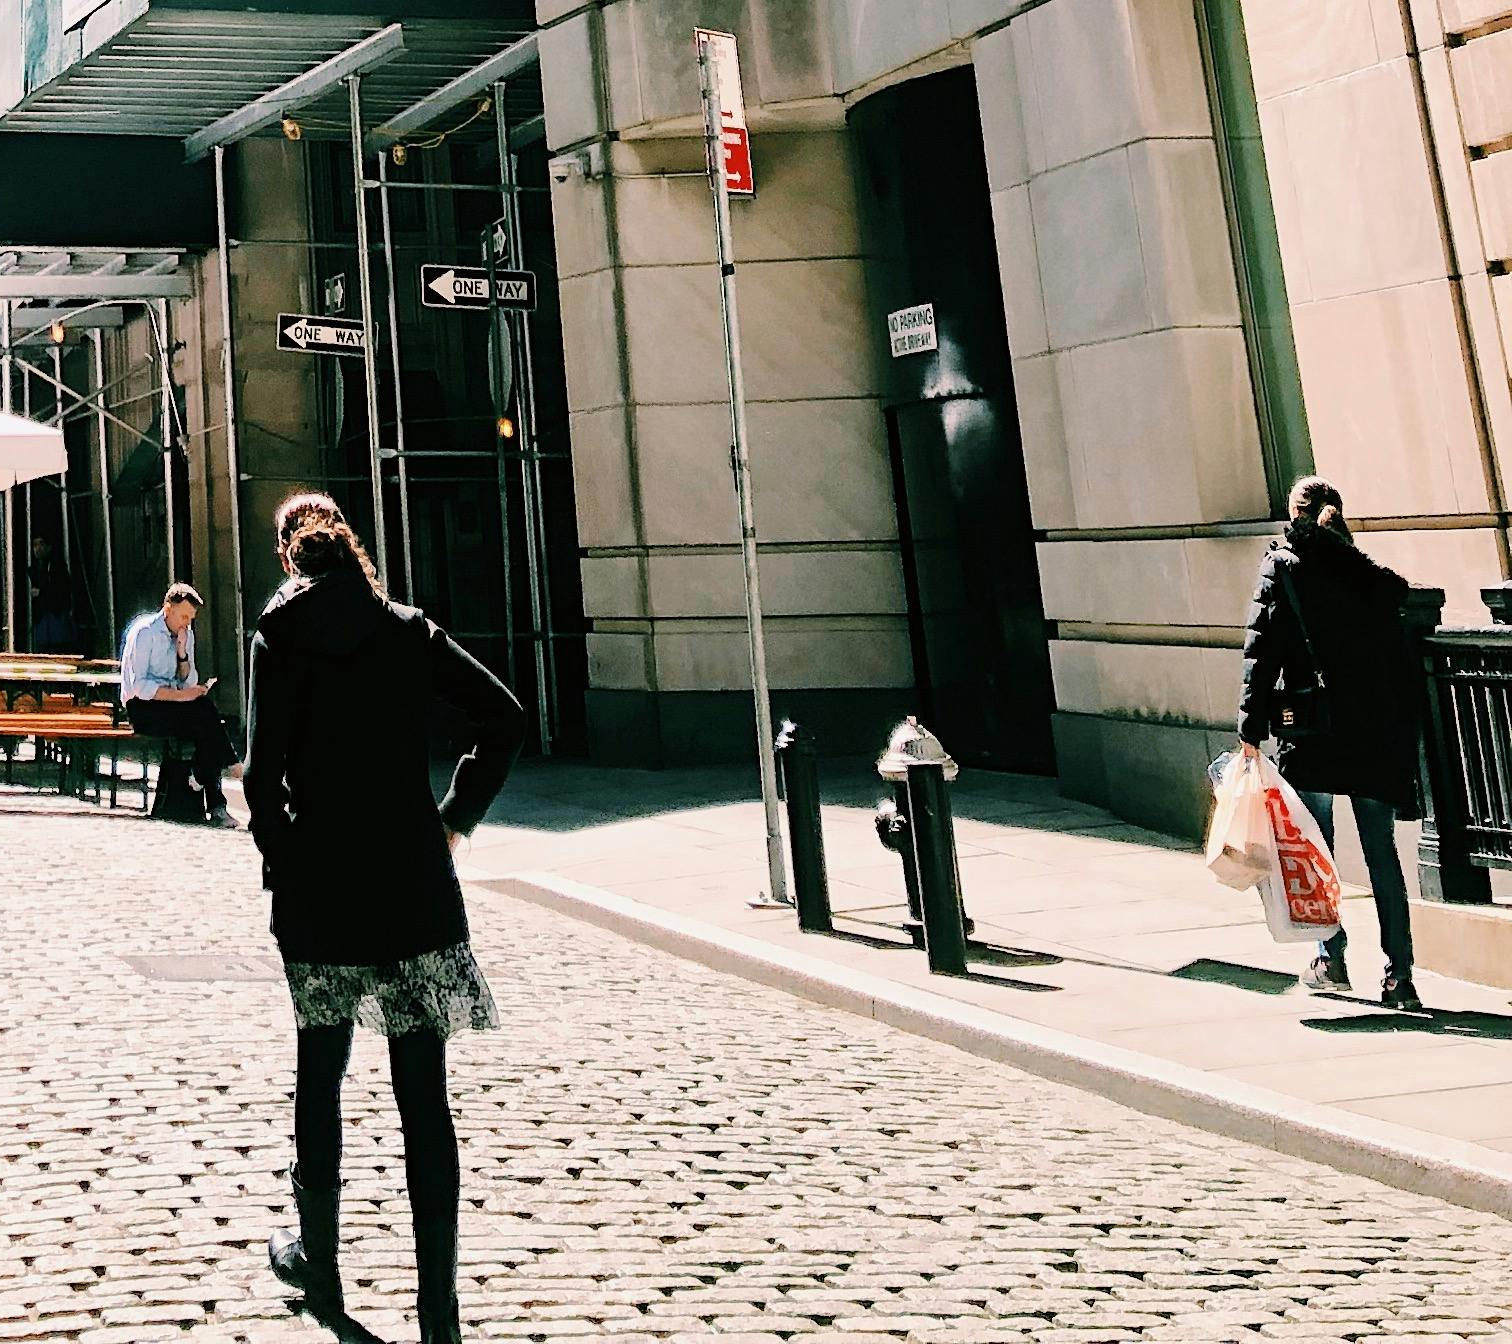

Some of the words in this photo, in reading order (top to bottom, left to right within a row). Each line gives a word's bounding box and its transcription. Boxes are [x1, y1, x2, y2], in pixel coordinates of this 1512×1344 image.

[452, 280, 483, 295] ONE
[900, 308, 932, 331] PARKING
[294, 326, 321, 341] ONE
[335, 329, 365, 346] WAY
